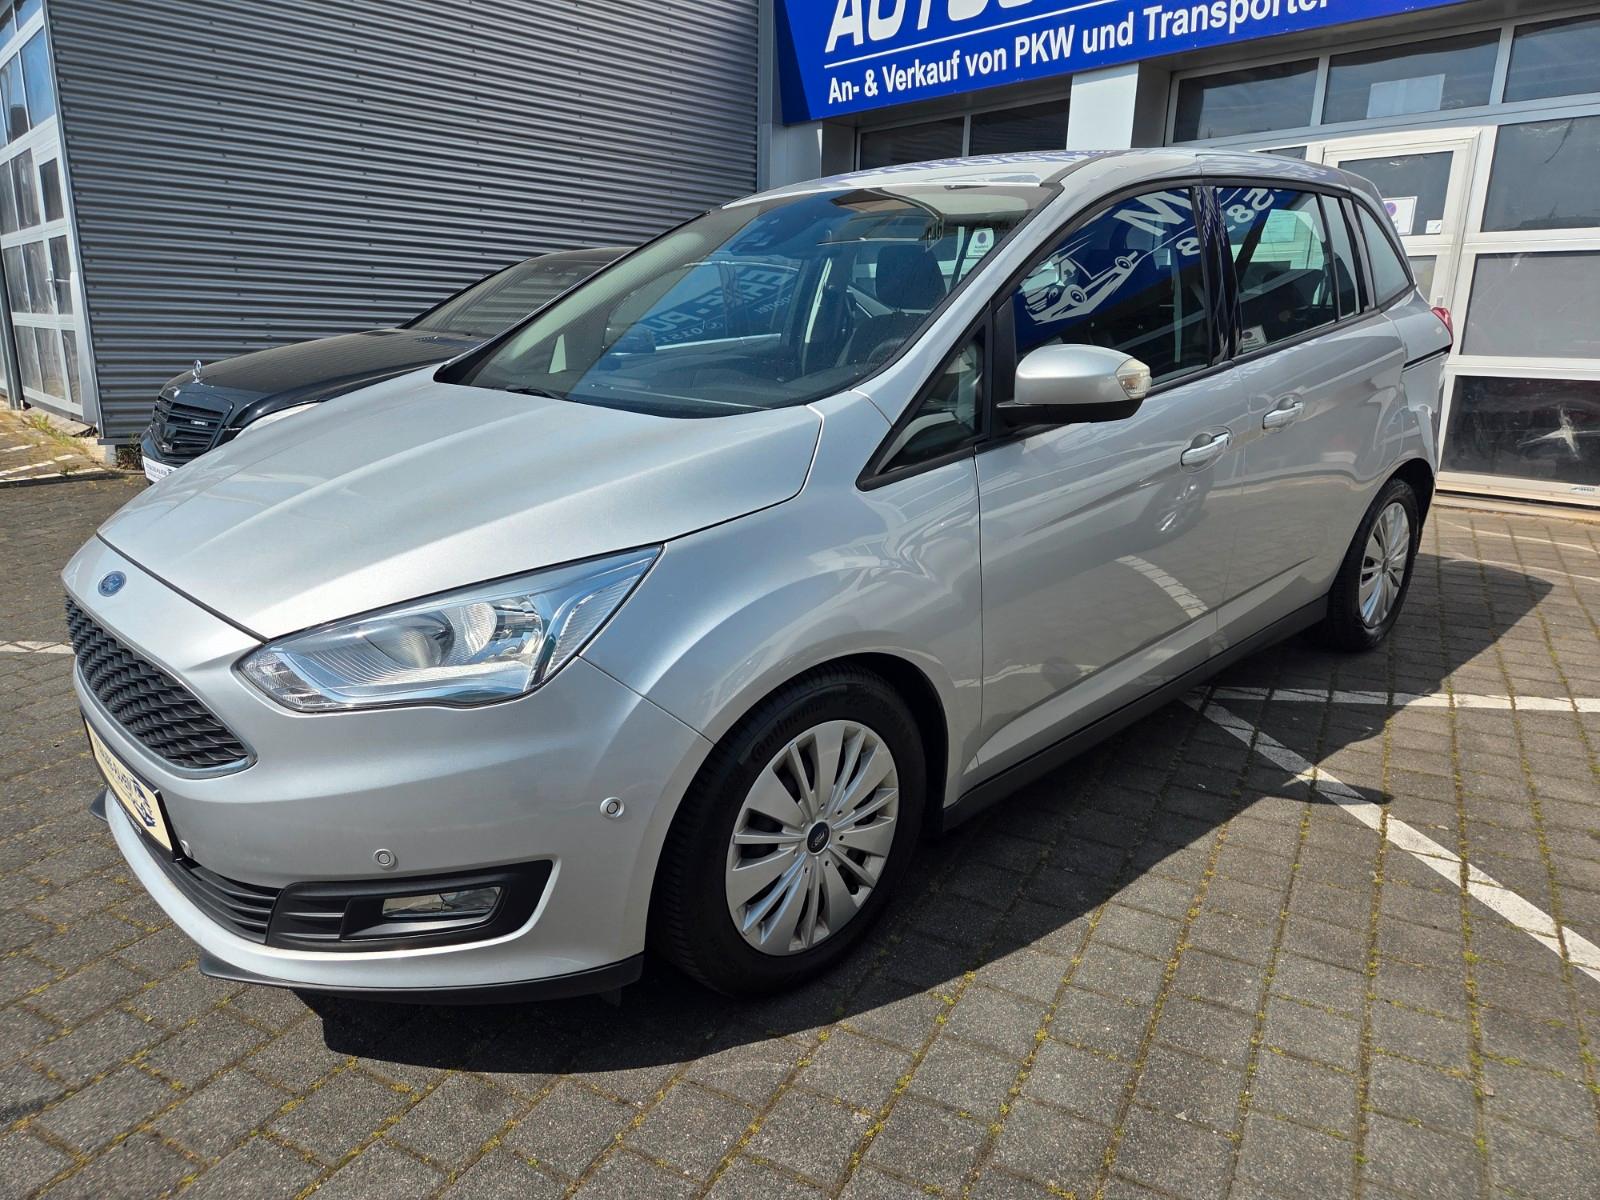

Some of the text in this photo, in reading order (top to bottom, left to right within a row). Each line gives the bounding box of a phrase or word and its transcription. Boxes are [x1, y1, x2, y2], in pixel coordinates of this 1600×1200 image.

[828, 77, 859, 104] An-
[864, 69, 879, 97] &
[882, 49, 961, 93] Verkauf
[965, 48, 1007, 77] von
[1015, 24, 1075, 68] PKW
[1083, 12, 1134, 54] und
